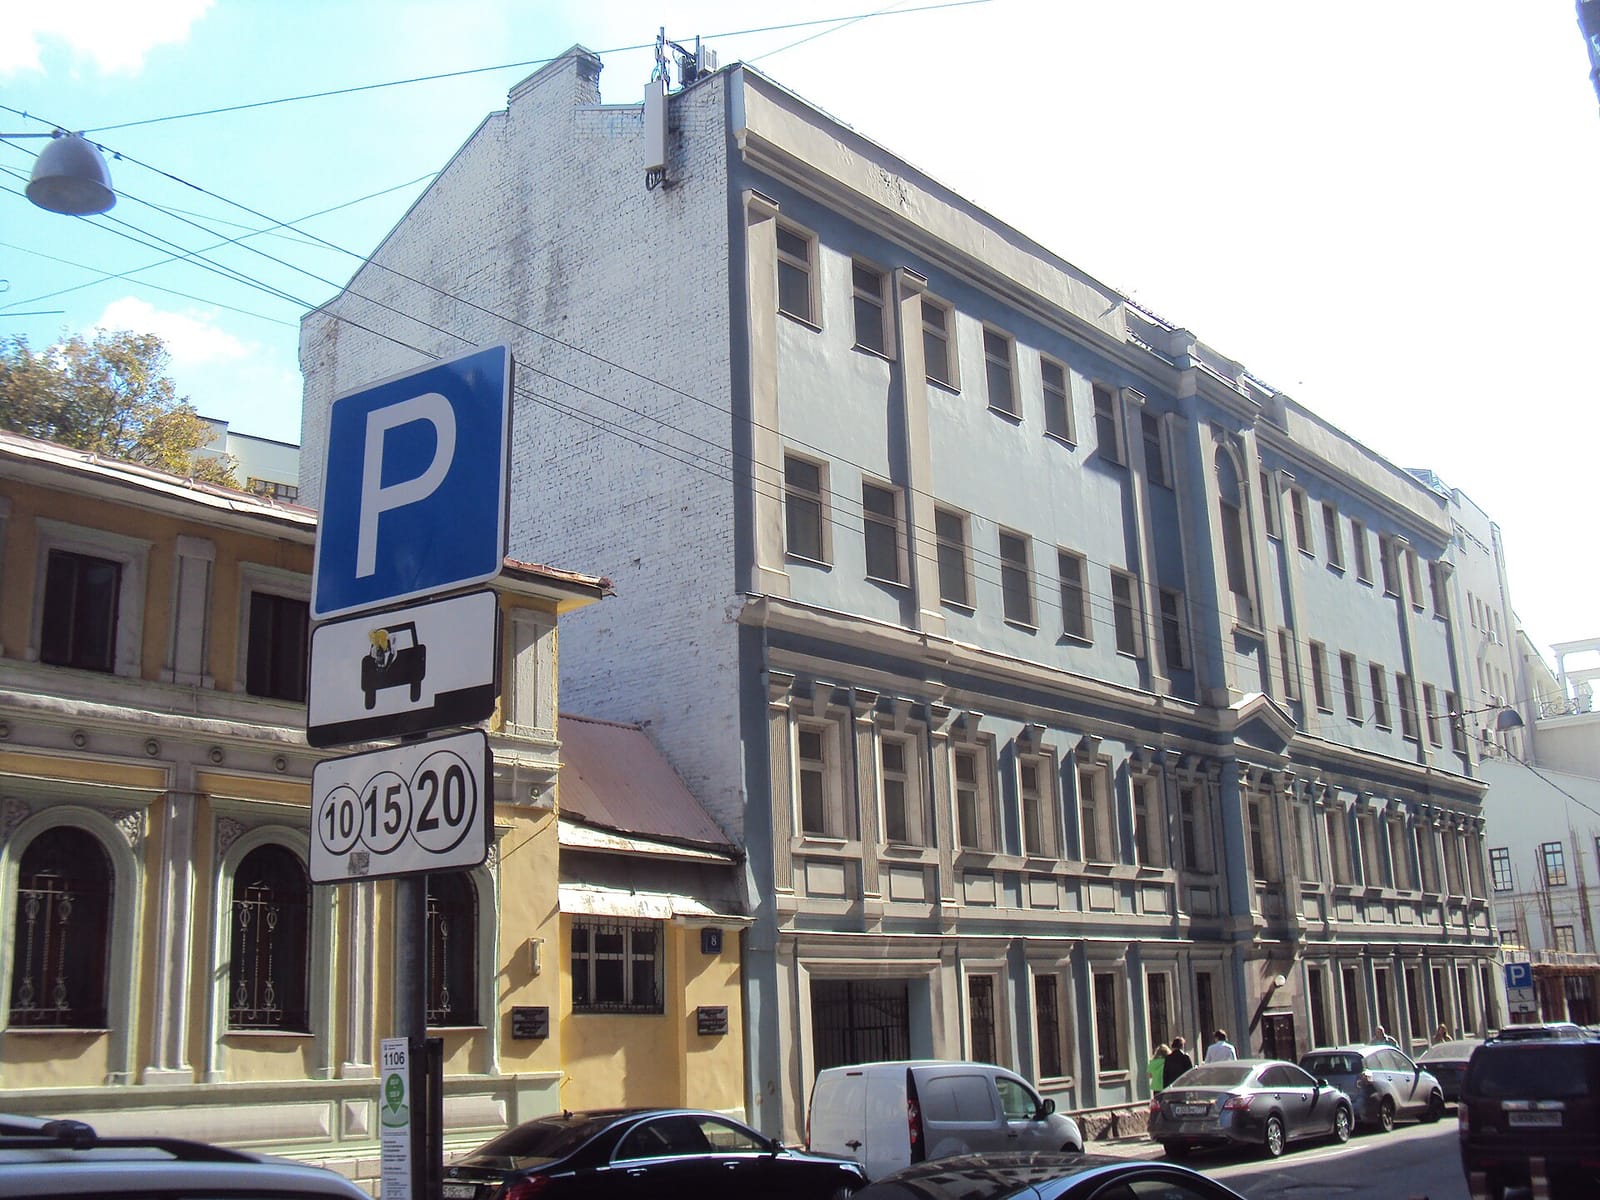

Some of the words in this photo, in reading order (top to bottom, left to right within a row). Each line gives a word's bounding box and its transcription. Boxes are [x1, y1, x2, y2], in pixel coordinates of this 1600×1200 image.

[355, 392, 457, 579] P
[325, 799, 354, 840] 10
[364, 785, 402, 837] 15
[416, 764, 466, 833] 20
[711, 935, 717, 946] 8
[1510, 965, 1525, 986] P
[384, 1051, 405, 1066] 1106
